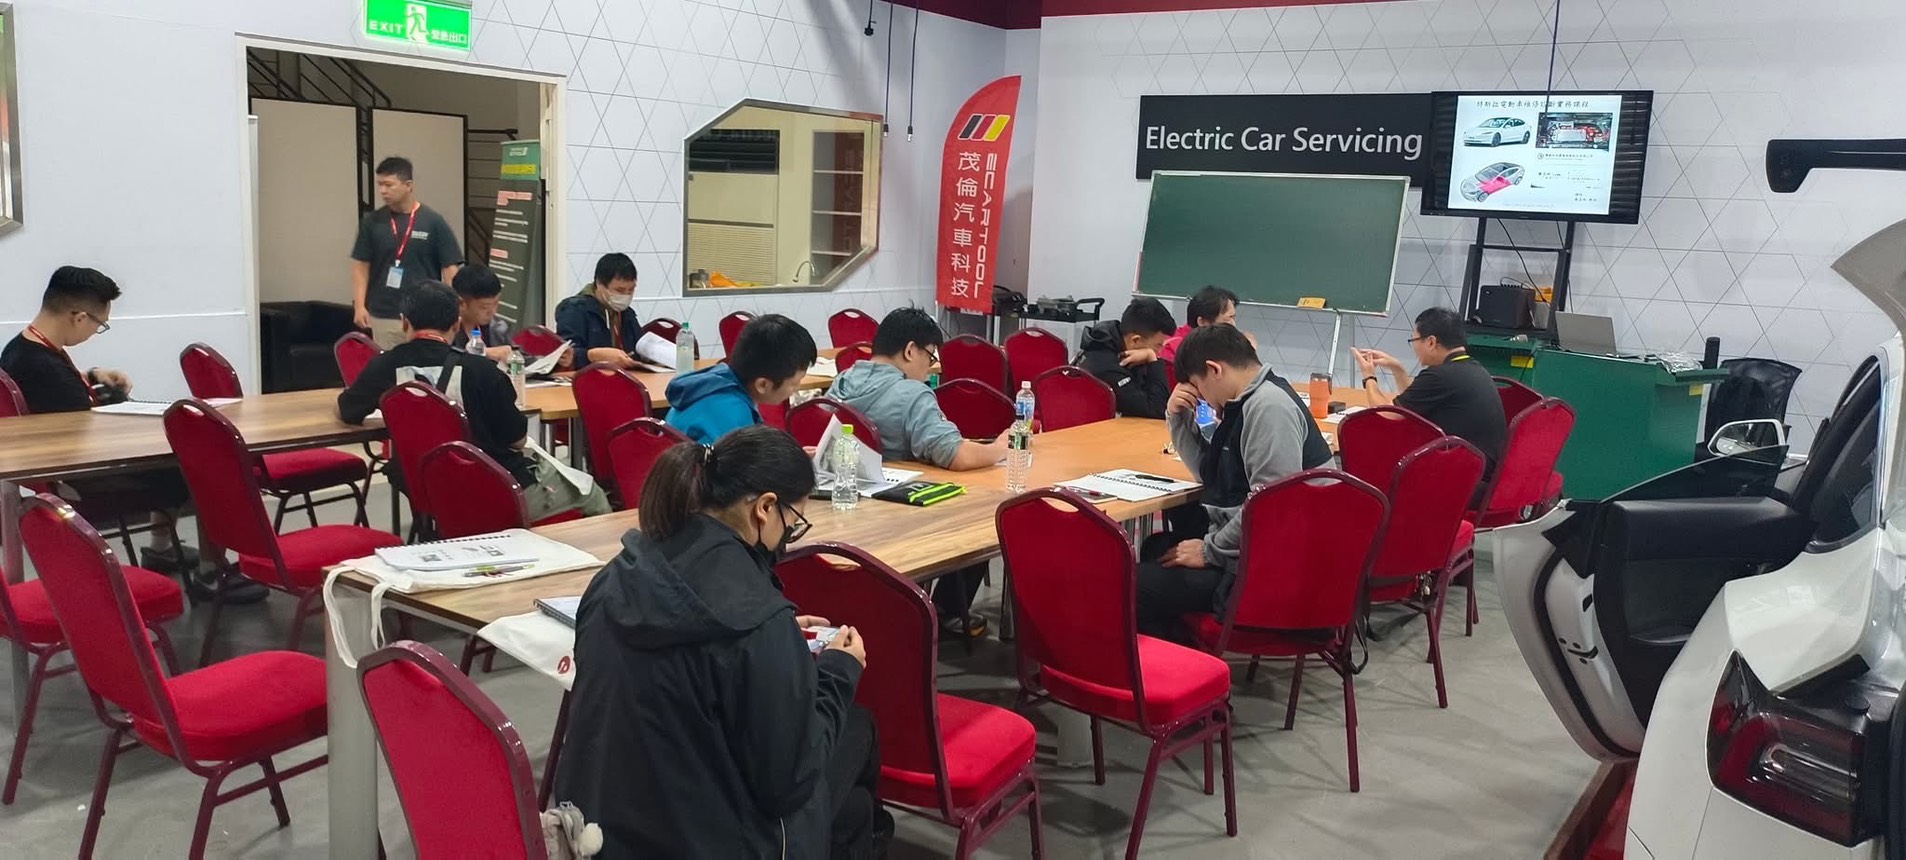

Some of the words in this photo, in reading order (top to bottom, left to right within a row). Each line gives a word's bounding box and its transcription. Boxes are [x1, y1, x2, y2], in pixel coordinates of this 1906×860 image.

[369, 21, 403, 34] EXIT
[1146, 125, 1234, 150] Electric
[1241, 127, 1286, 151] Car
[1292, 127, 1423, 160] Servicing
[951, 151, 981, 298] 茂倫汽車科技
[973, 153, 998, 299] ECARTOOL
